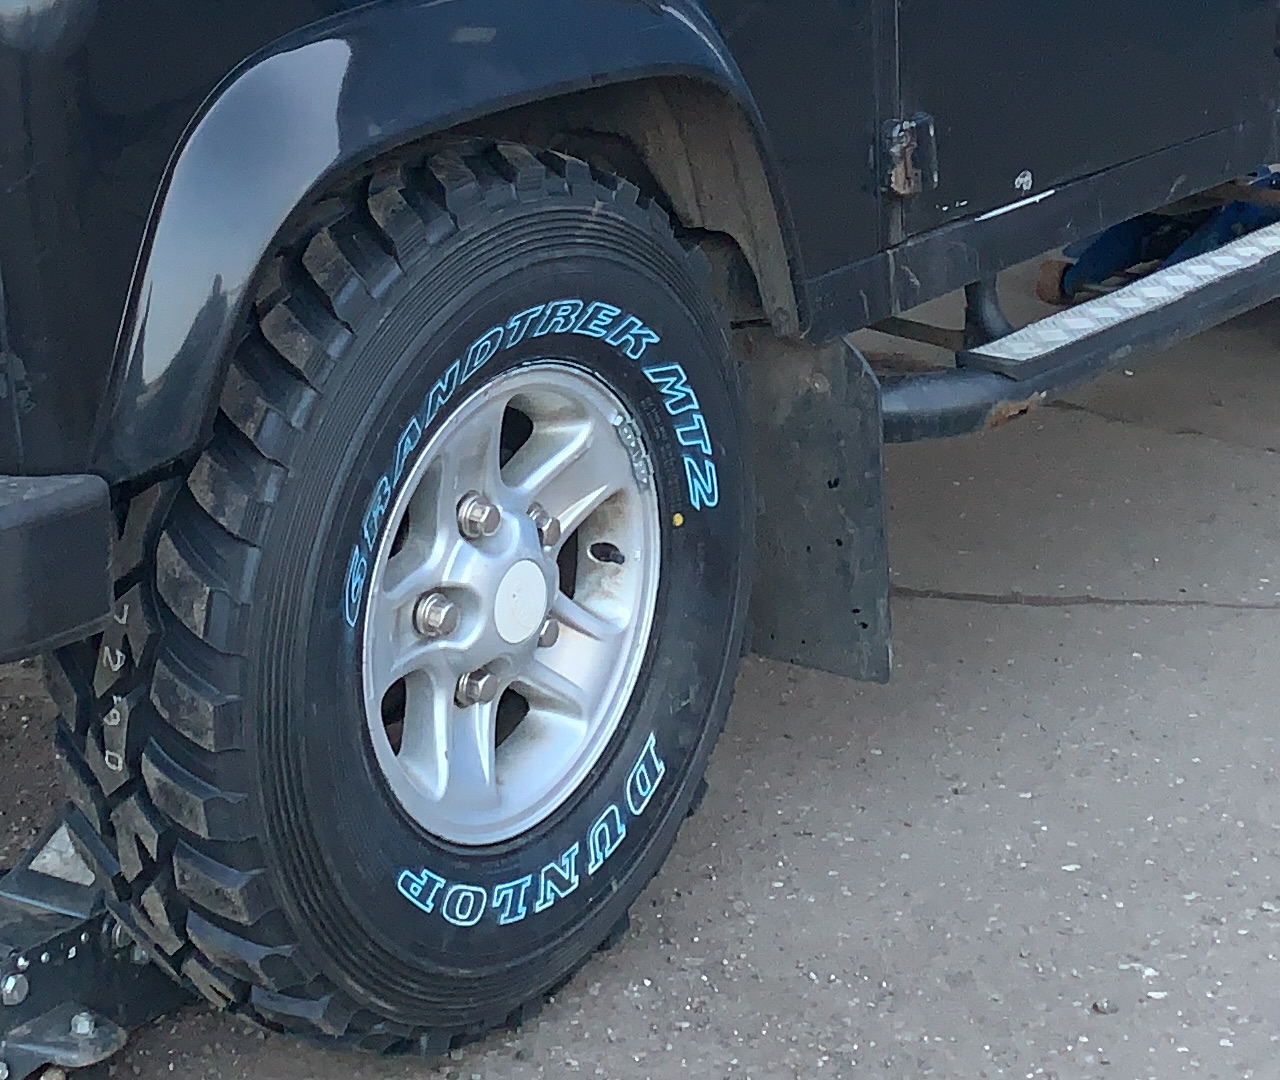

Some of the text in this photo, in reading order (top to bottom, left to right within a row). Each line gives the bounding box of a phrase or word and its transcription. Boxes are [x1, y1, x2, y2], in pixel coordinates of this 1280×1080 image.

[344, 299, 660, 628] GRANDTREK
[645, 361, 720, 511] MT2
[397, 732, 667, 926] DUNLOP
